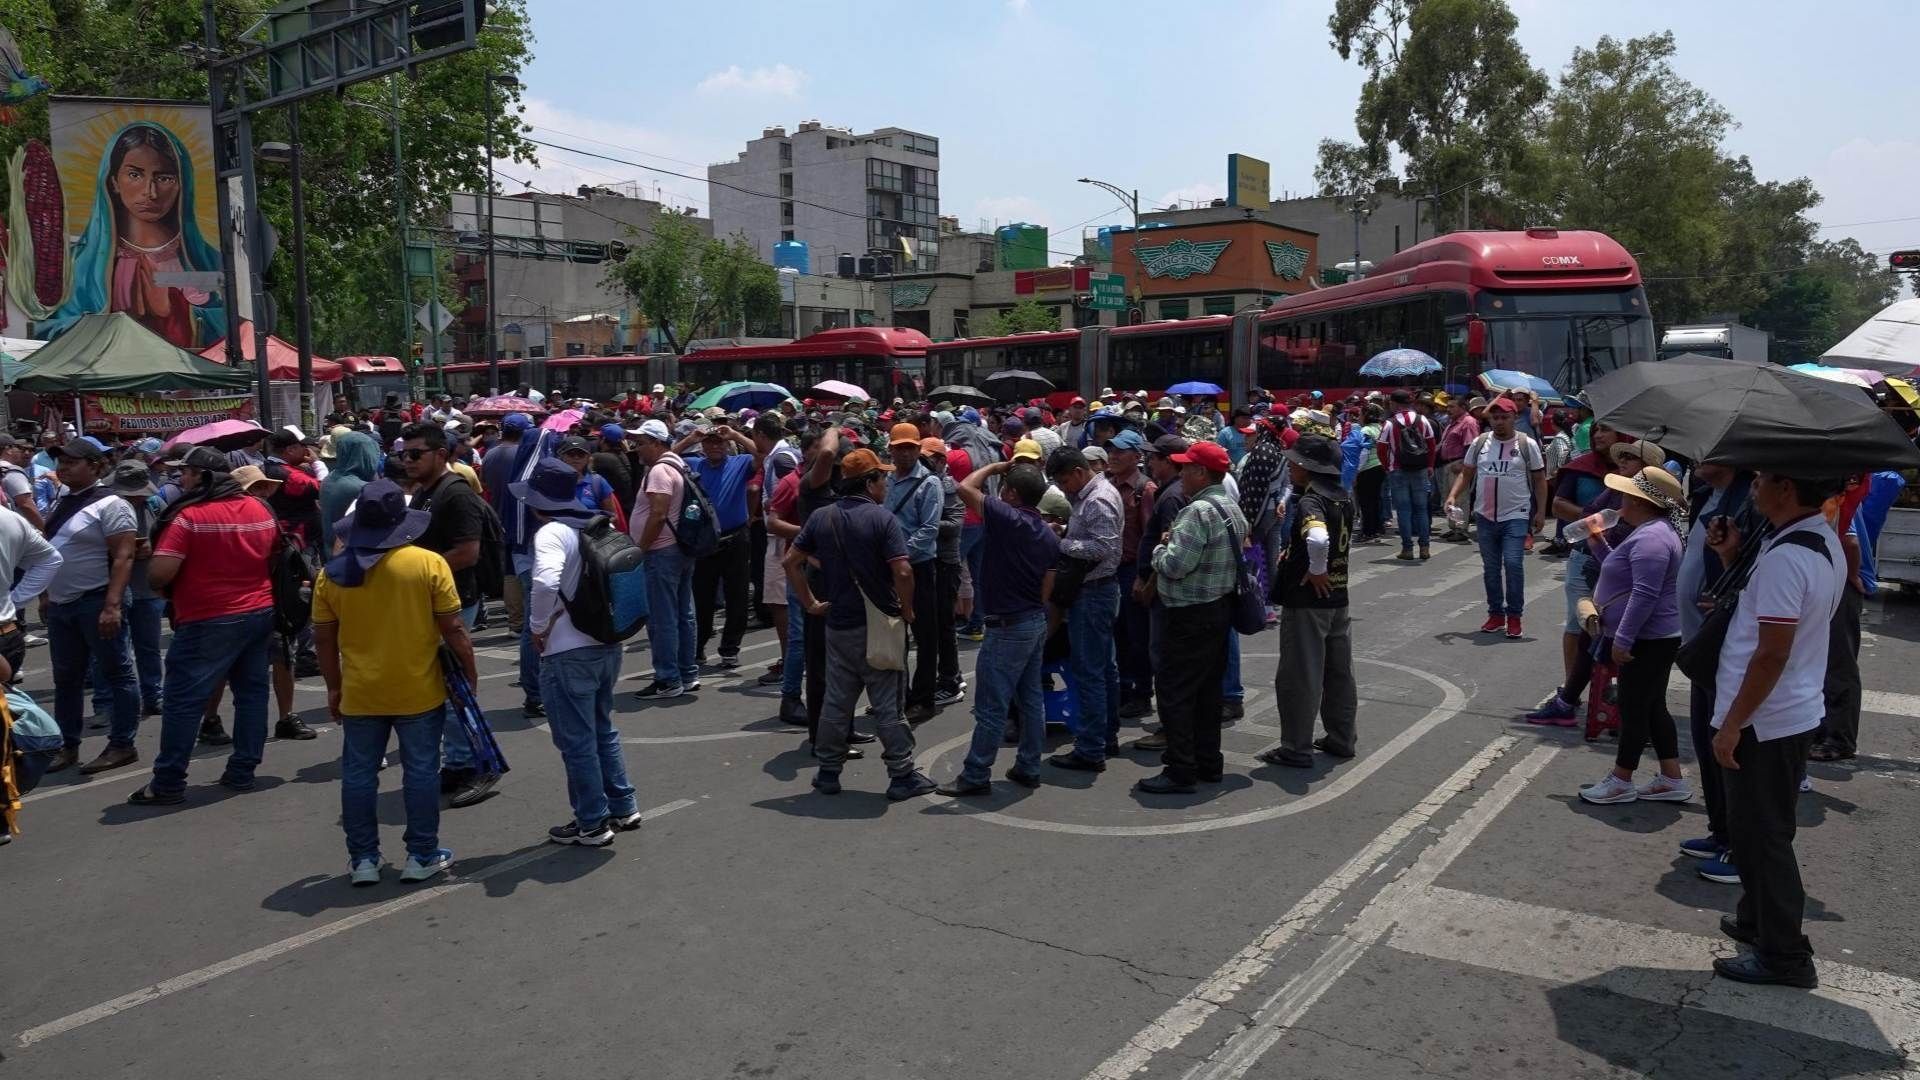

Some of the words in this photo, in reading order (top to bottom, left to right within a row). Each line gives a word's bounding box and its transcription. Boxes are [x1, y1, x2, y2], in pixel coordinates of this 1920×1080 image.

[1542, 256, 1580, 264] CDMX
[99, 396, 137, 414] RICOS
[139, 398, 175, 414] TACOS
[176, 398, 191, 412] DE
[120, 417, 159, 429] PEDIDOS
[160, 416, 173, 428] AL
